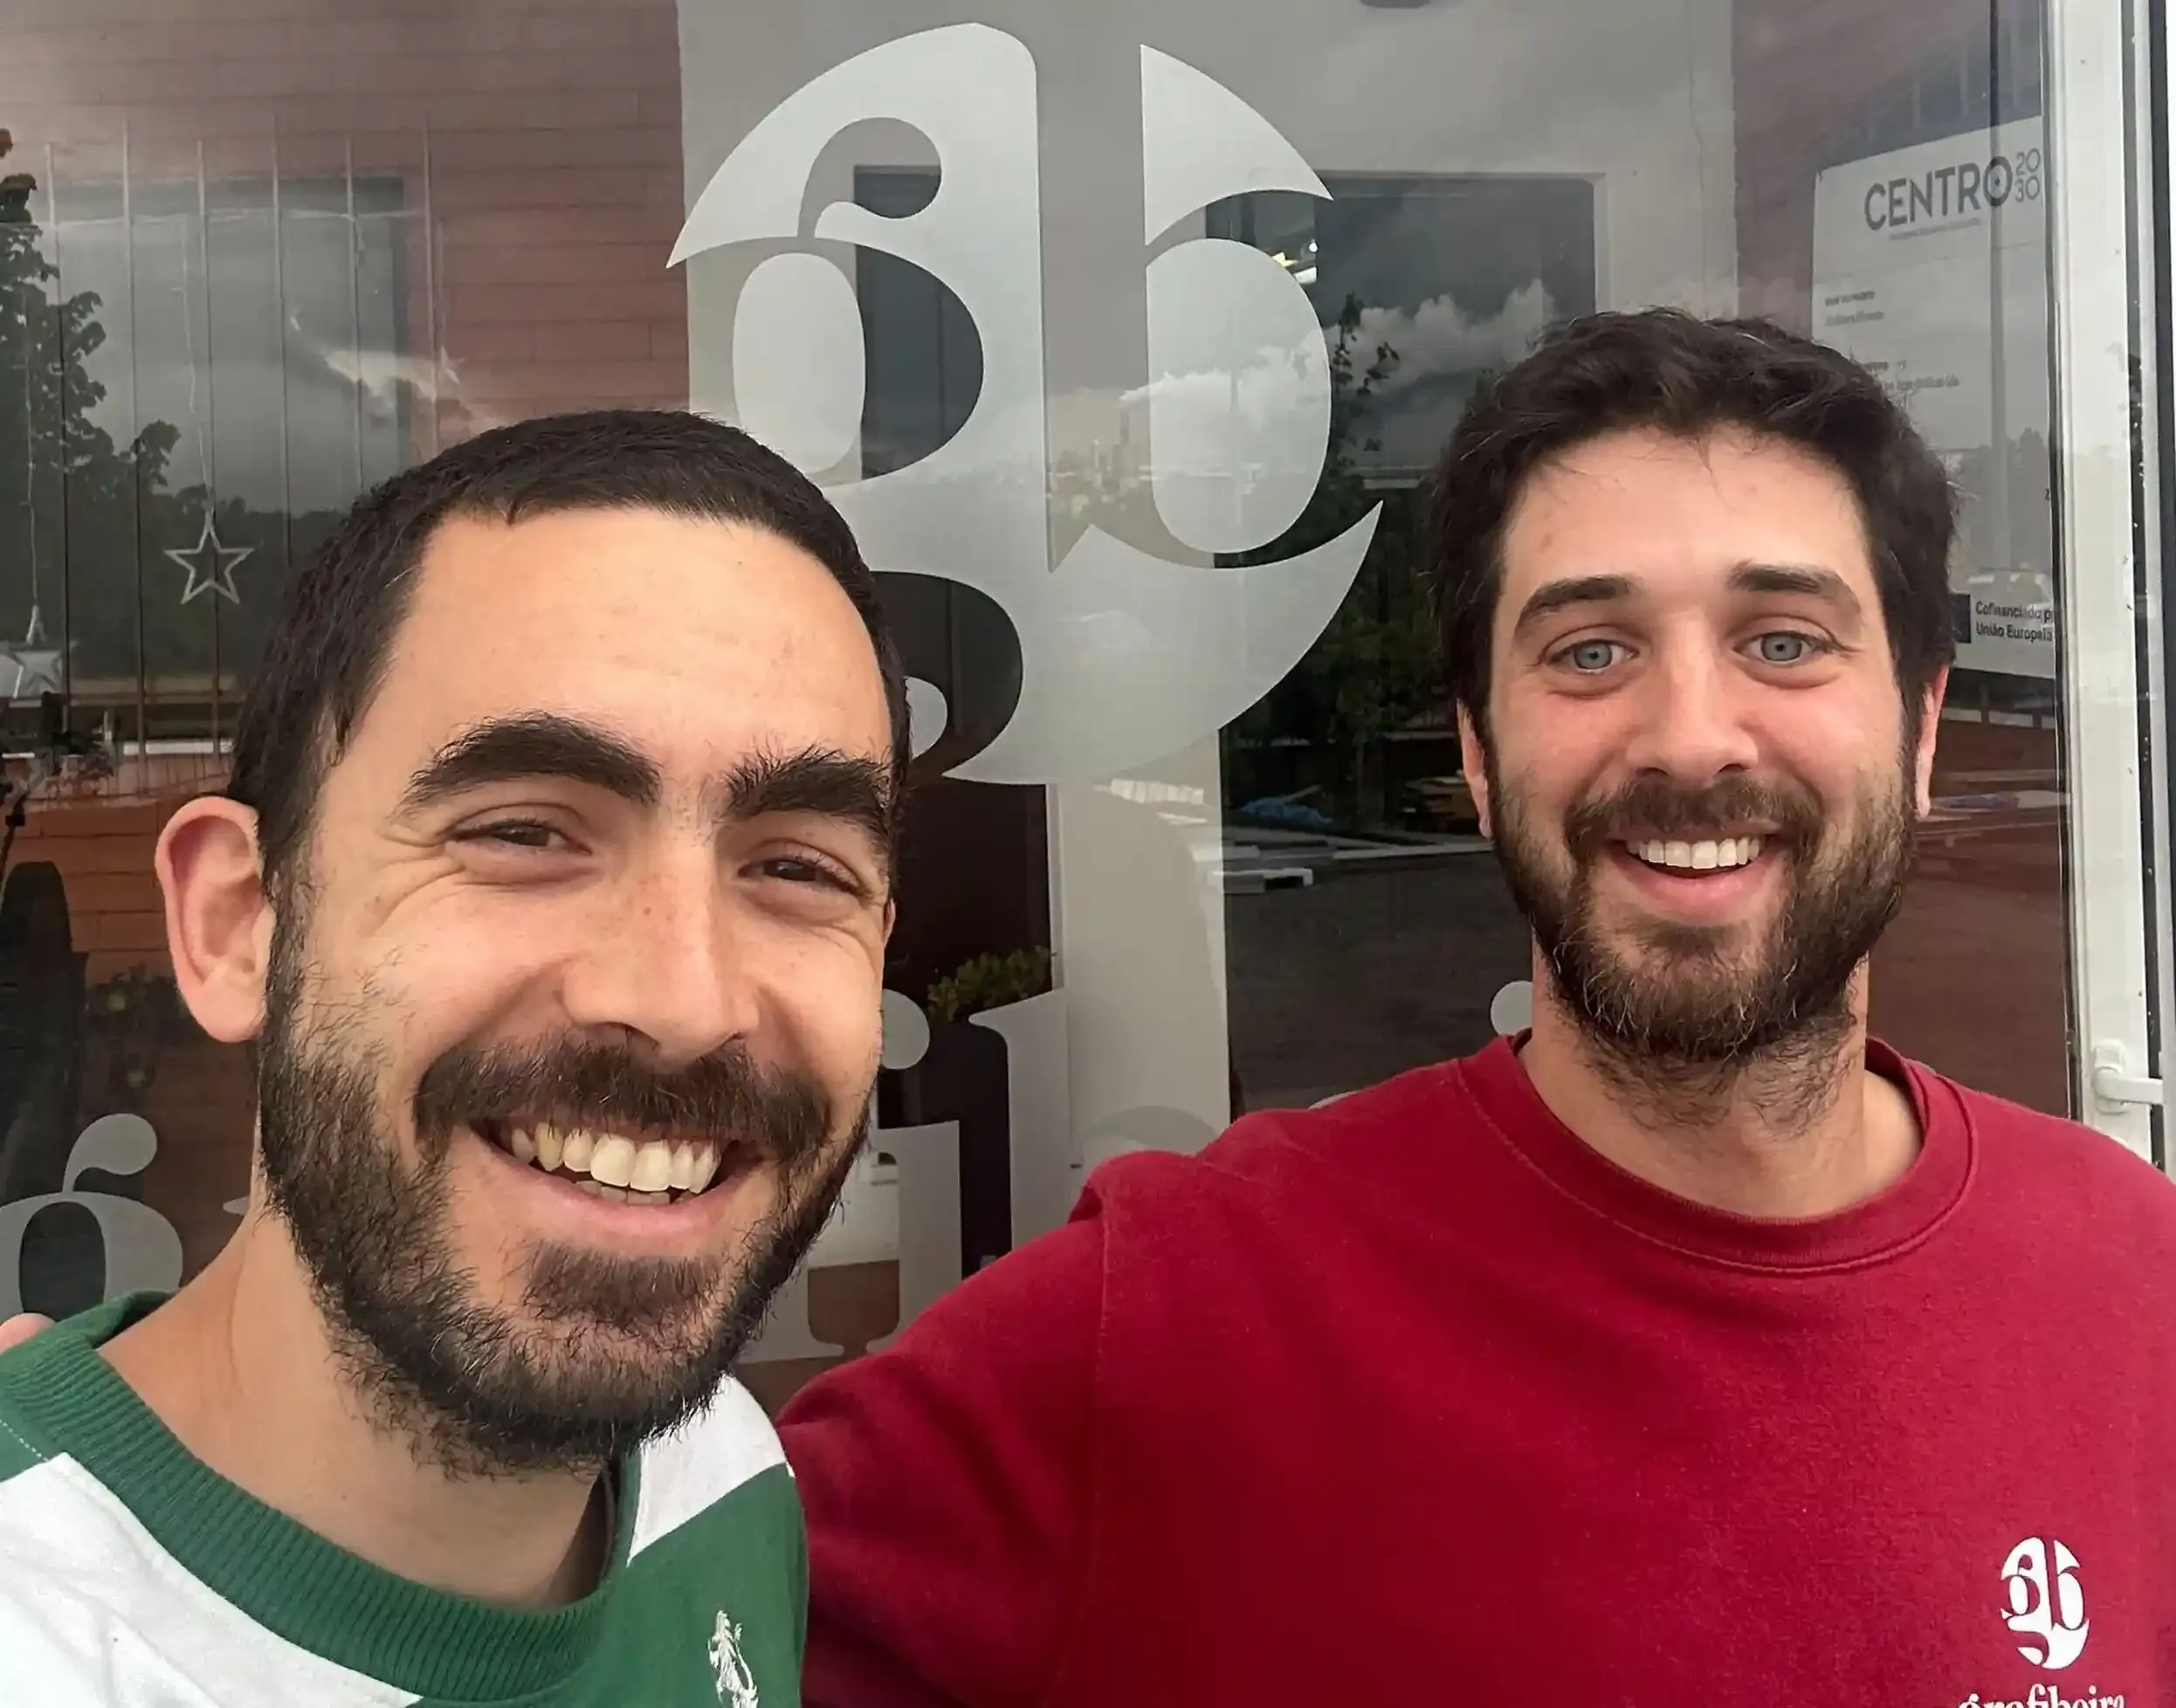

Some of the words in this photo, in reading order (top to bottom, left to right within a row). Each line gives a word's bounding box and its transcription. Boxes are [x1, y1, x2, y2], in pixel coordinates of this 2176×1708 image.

[2015, 148, 2041, 176] 20
[1863, 155, 2013, 230] CENTRO
[2014, 176, 2040, 203] 30
